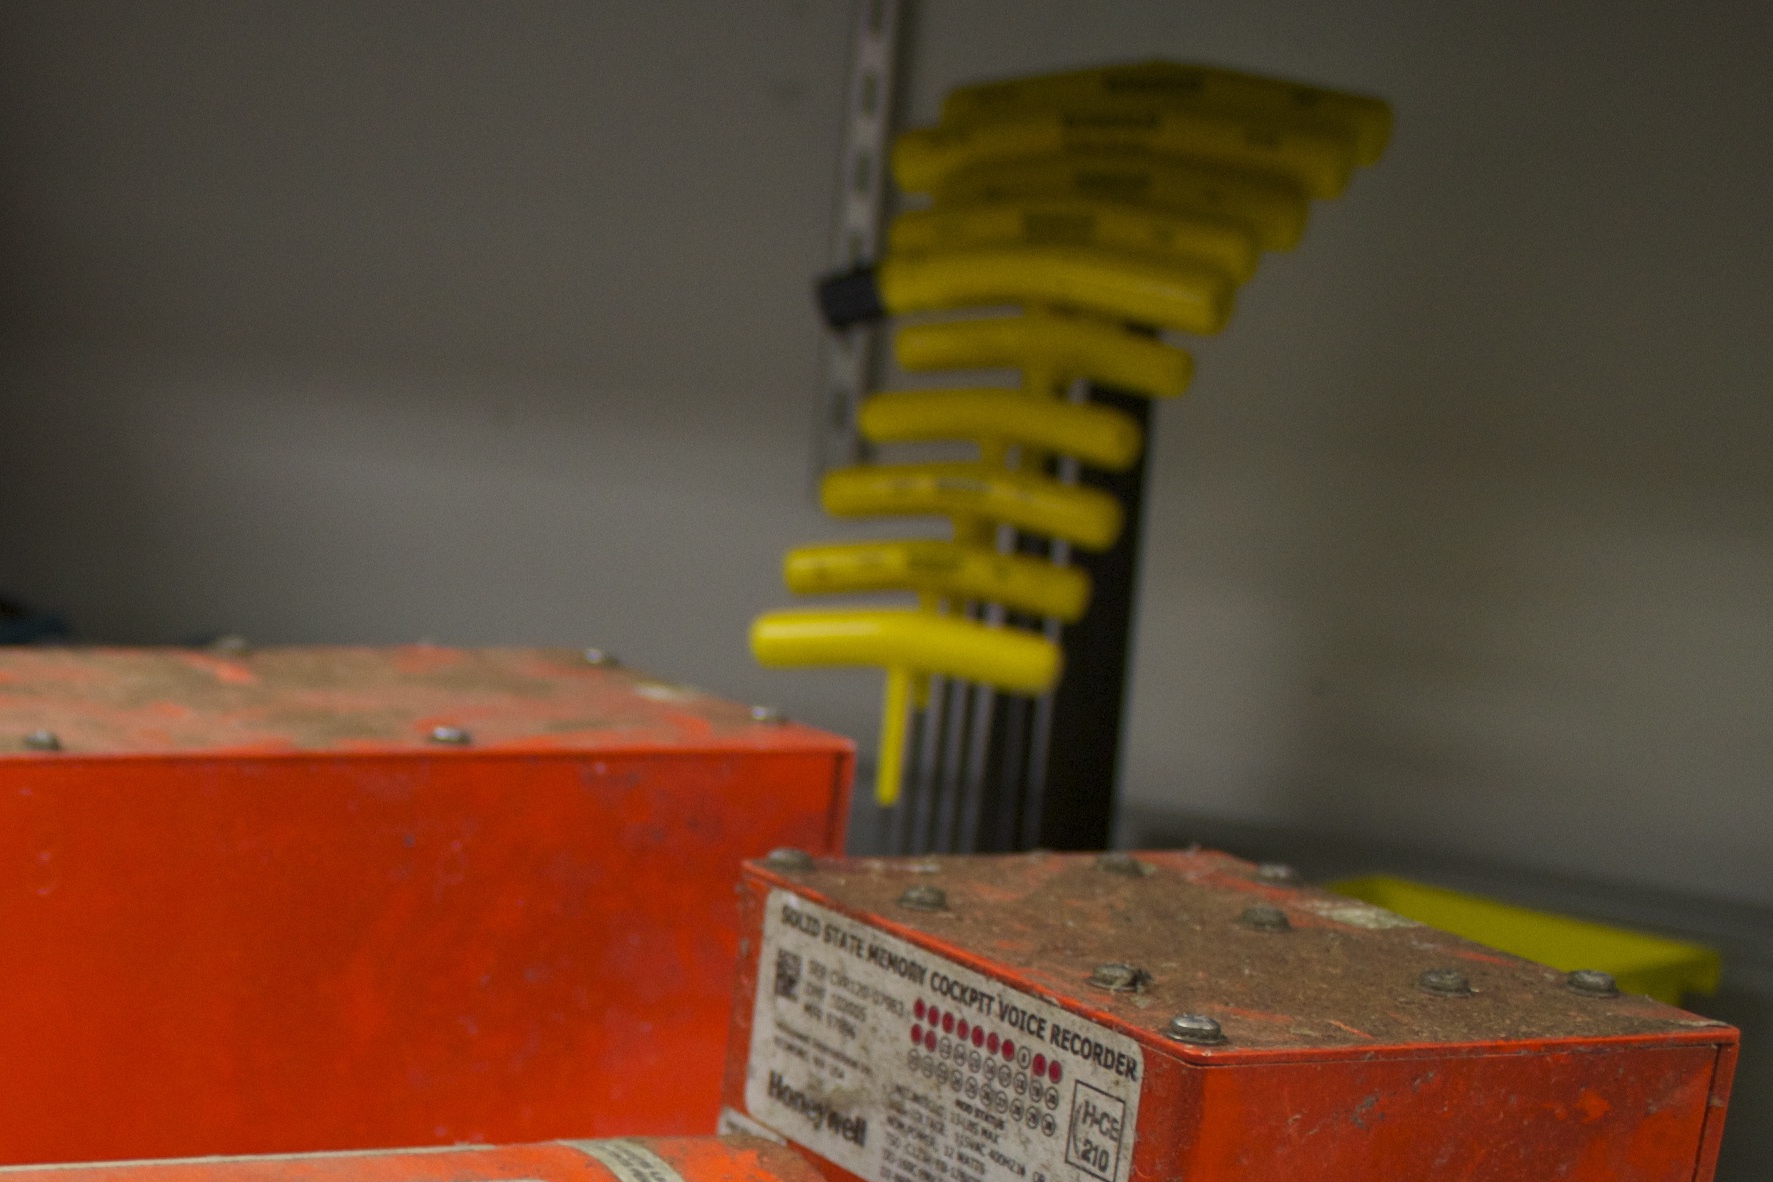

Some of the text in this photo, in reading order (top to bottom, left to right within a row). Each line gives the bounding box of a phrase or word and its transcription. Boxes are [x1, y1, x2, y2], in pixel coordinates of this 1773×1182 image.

[780, 904, 820, 940] SOLID
[823, 922, 865, 960] STATE
[867, 942, 926, 987] MEMORY
[929, 969, 995, 1017] COCKPIT
[996, 998, 1046, 1040] VOICE
[1049, 1021, 1139, 1082] RECORDER
[767, 1070, 867, 1148] Honeywell
[1081, 1138, 1110, 1174] 210
